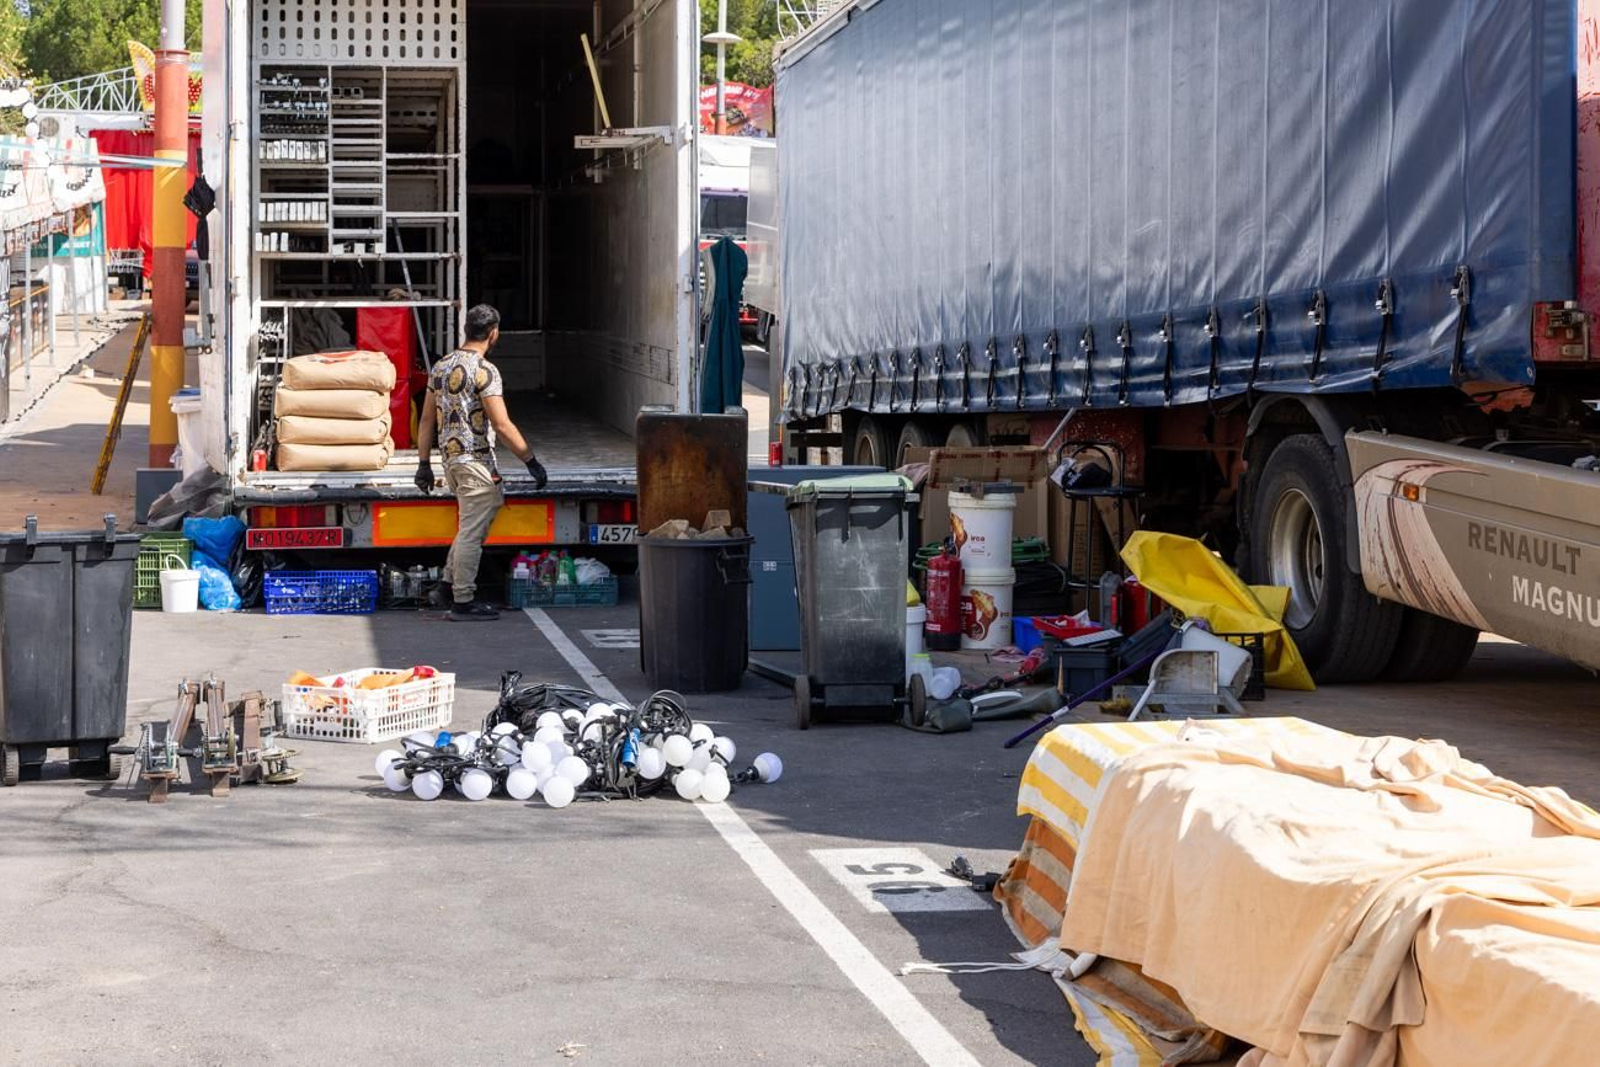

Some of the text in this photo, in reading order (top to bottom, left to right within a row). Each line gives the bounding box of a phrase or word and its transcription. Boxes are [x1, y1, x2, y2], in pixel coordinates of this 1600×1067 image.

[970, 533, 985, 541] irca
[1468, 522, 1581, 575] RENAULT
[1512, 575, 1600, 627] MAGNU
